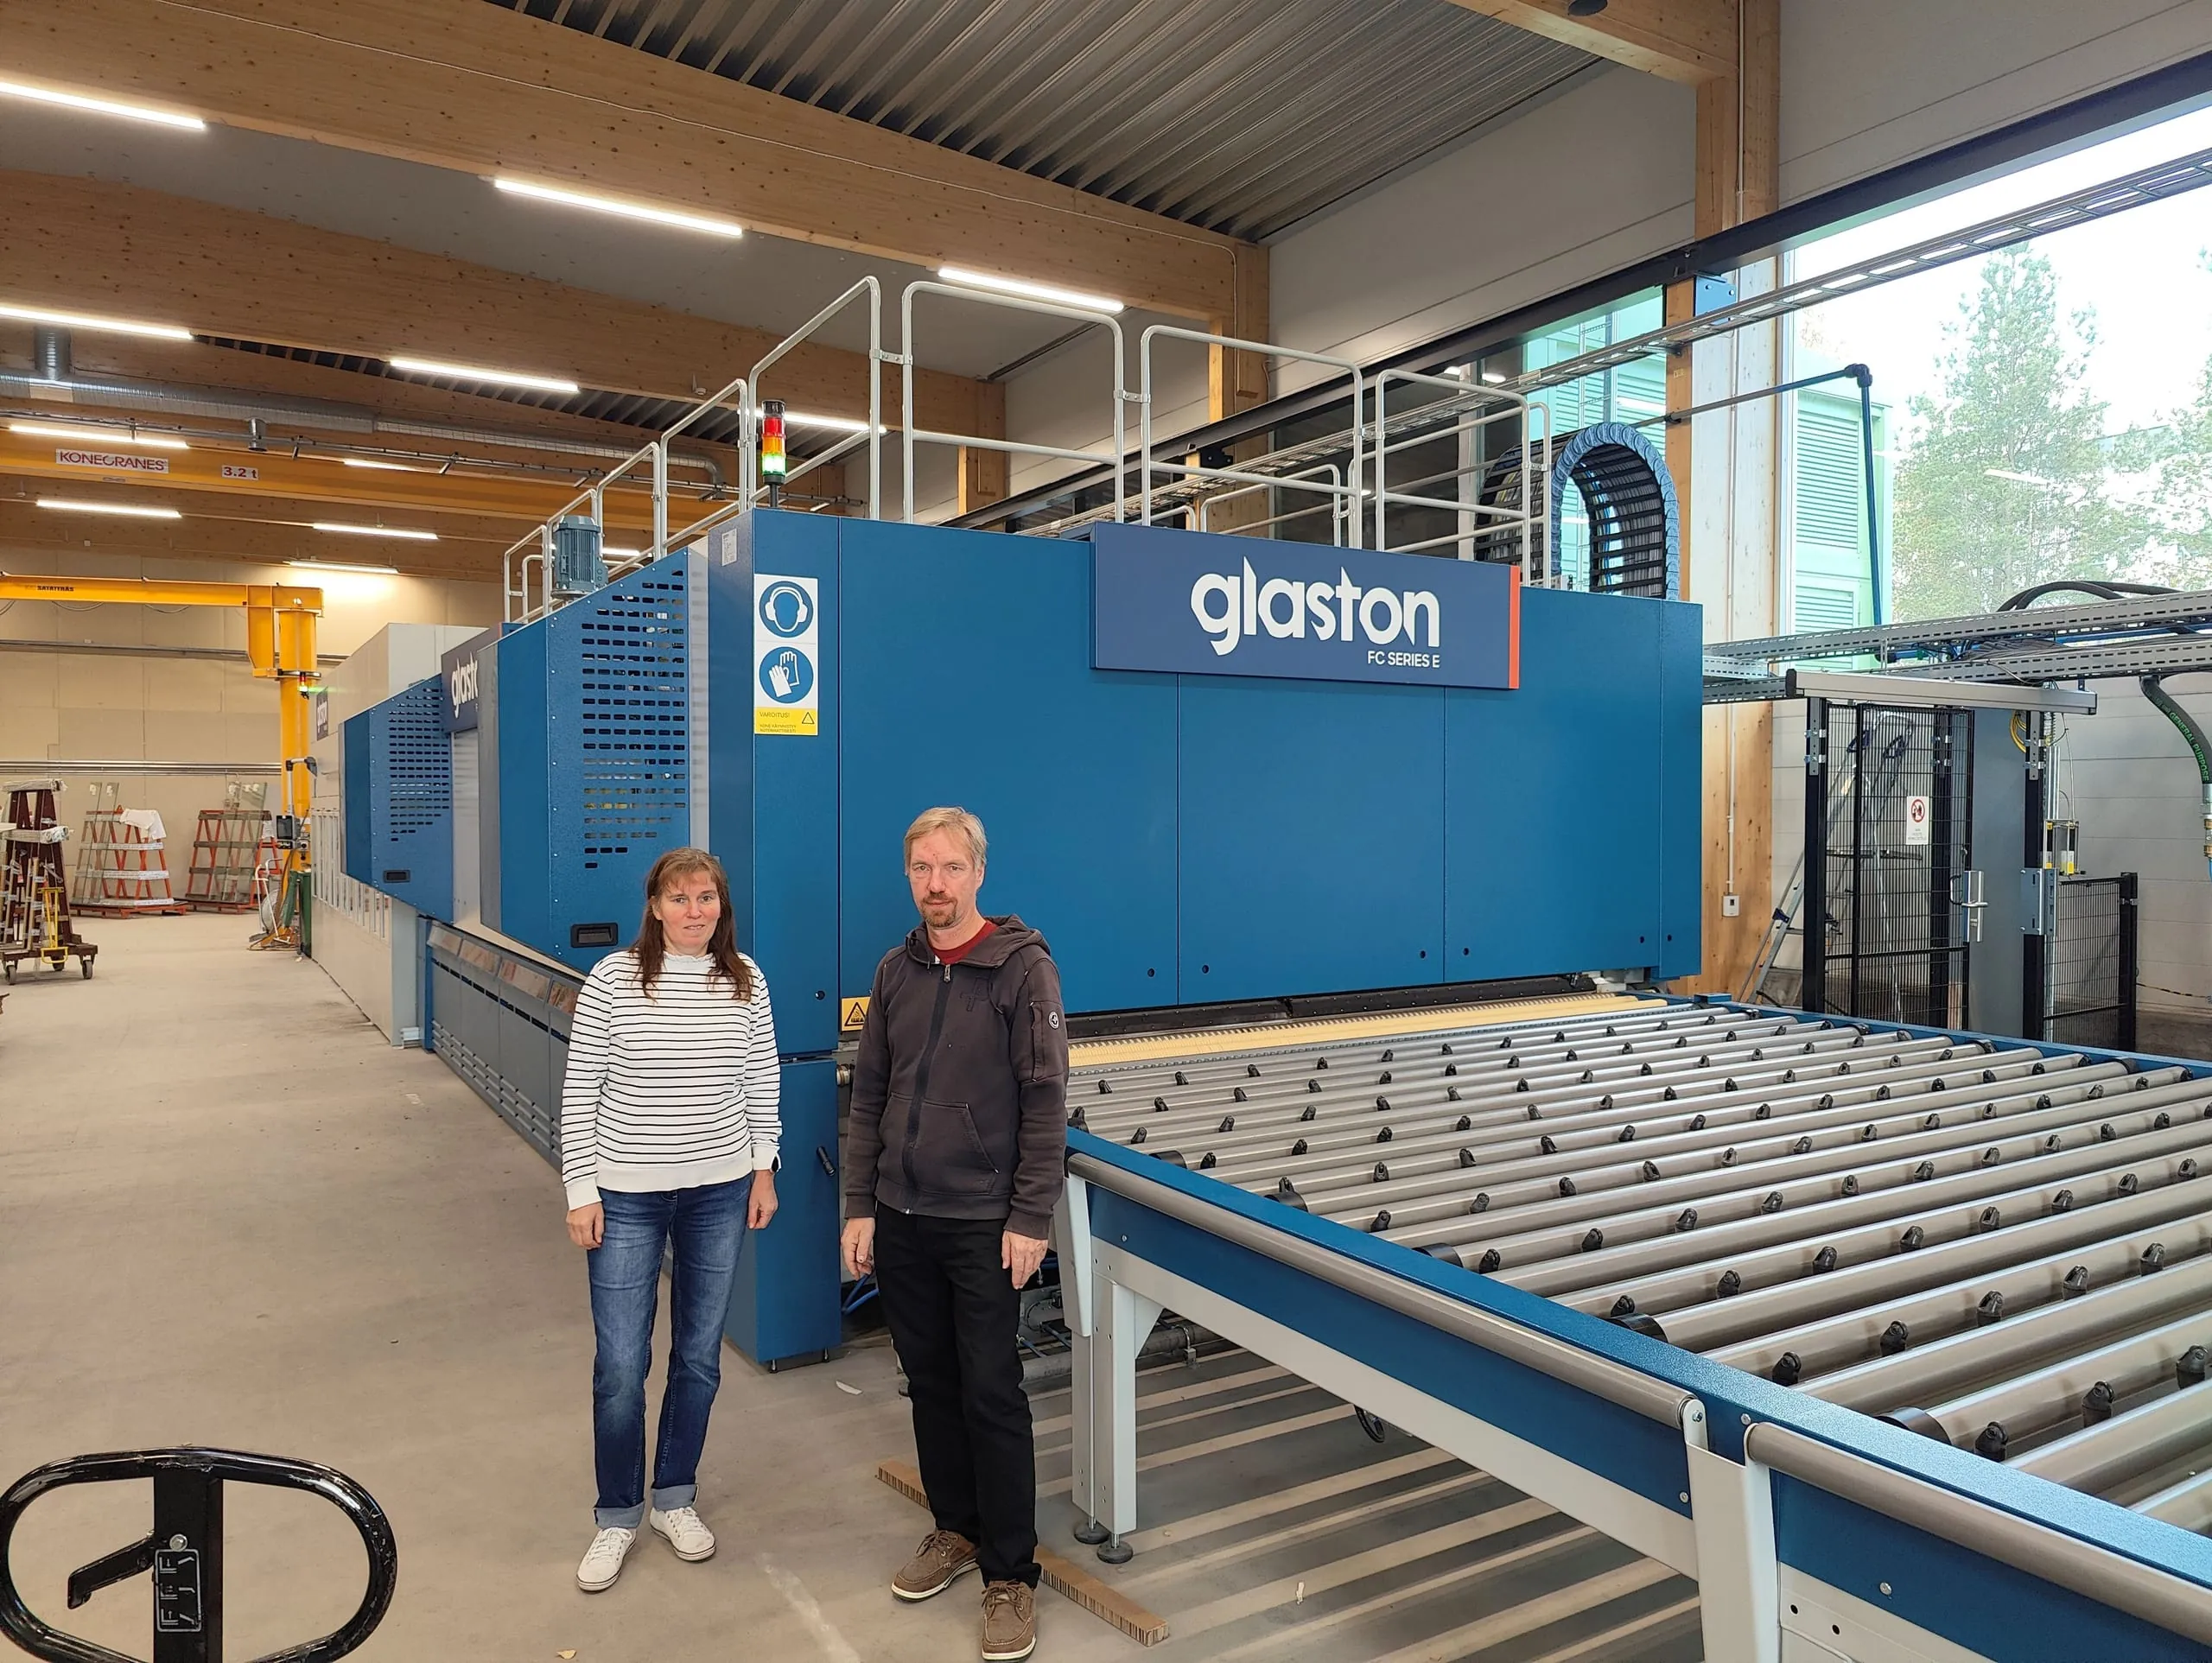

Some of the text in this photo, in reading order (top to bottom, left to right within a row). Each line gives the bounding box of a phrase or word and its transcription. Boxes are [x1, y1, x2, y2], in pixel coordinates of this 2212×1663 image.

[60, 451, 164, 471] KONECRANES
[224, 467, 257, 479] 3.2 t
[1191, 555, 1440, 657] glaston
[1367, 650, 1440, 668] FC SERIES E
[2169, 712, 2209, 781] GENERAL PURPOSE
